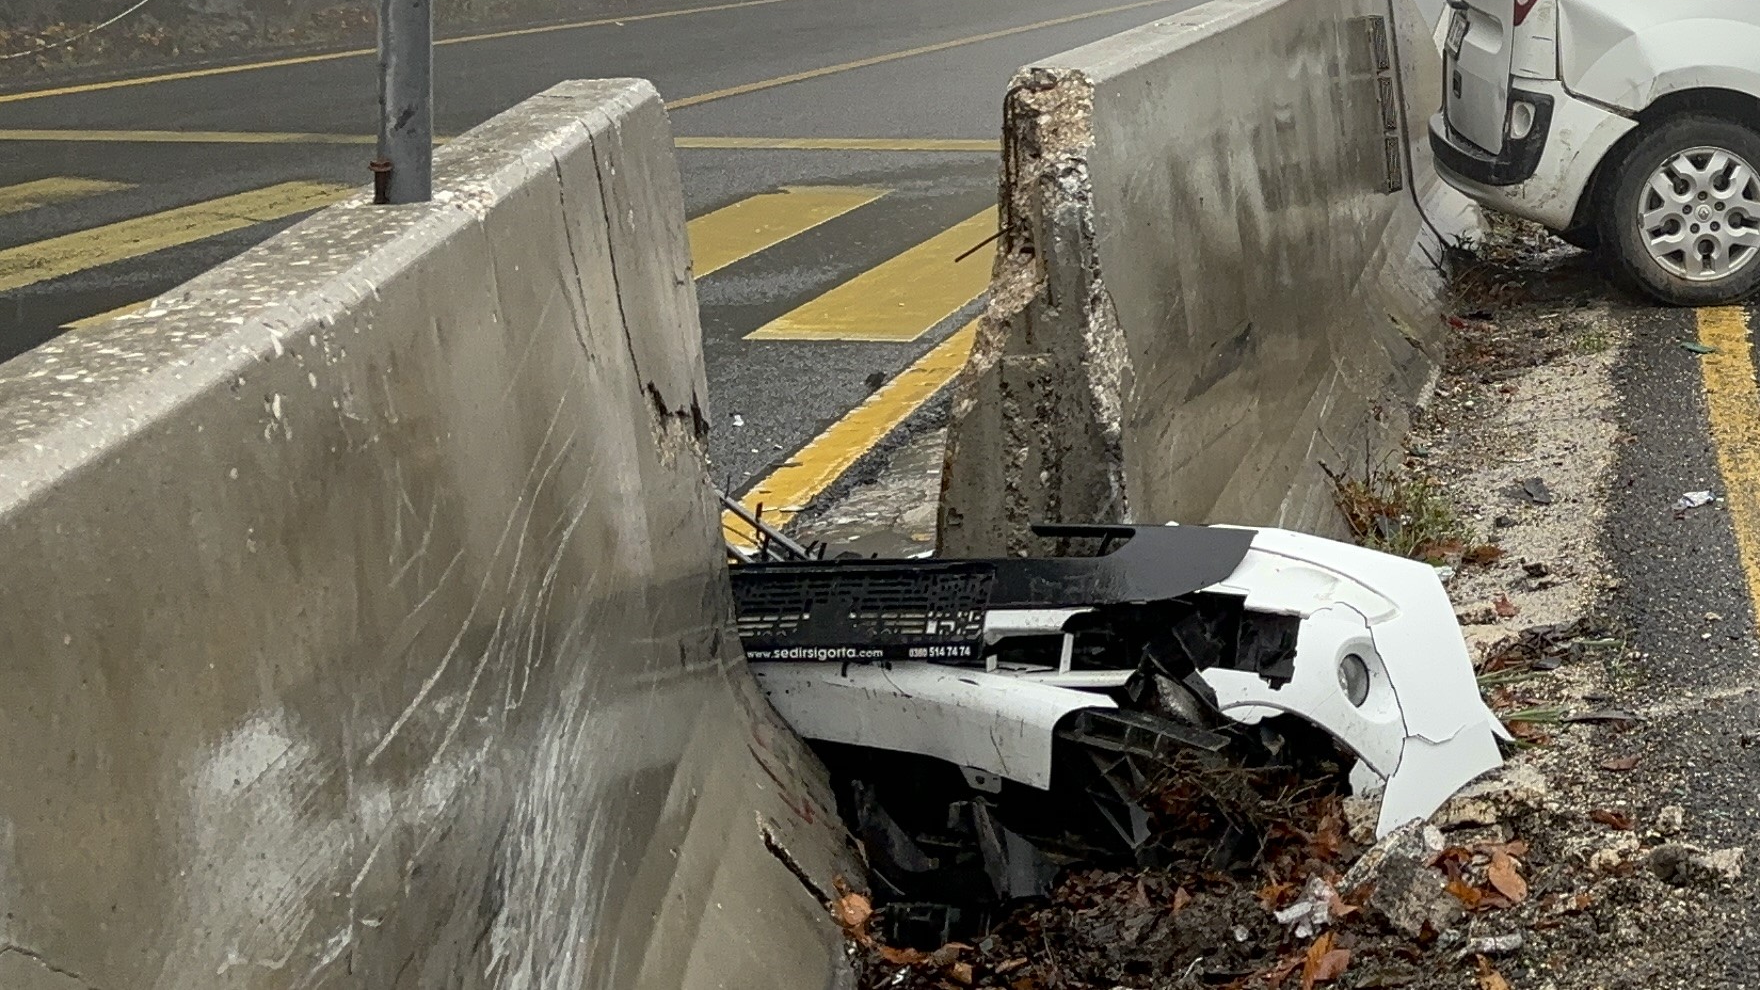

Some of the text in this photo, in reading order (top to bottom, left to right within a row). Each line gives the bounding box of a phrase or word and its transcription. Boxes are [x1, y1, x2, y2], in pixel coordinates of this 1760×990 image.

[747, 646, 883, 661] www.sedirsigorta.com
[929, 646, 945, 658] 514
[946, 646, 958, 657] 74
[959, 645, 971, 657] 74
